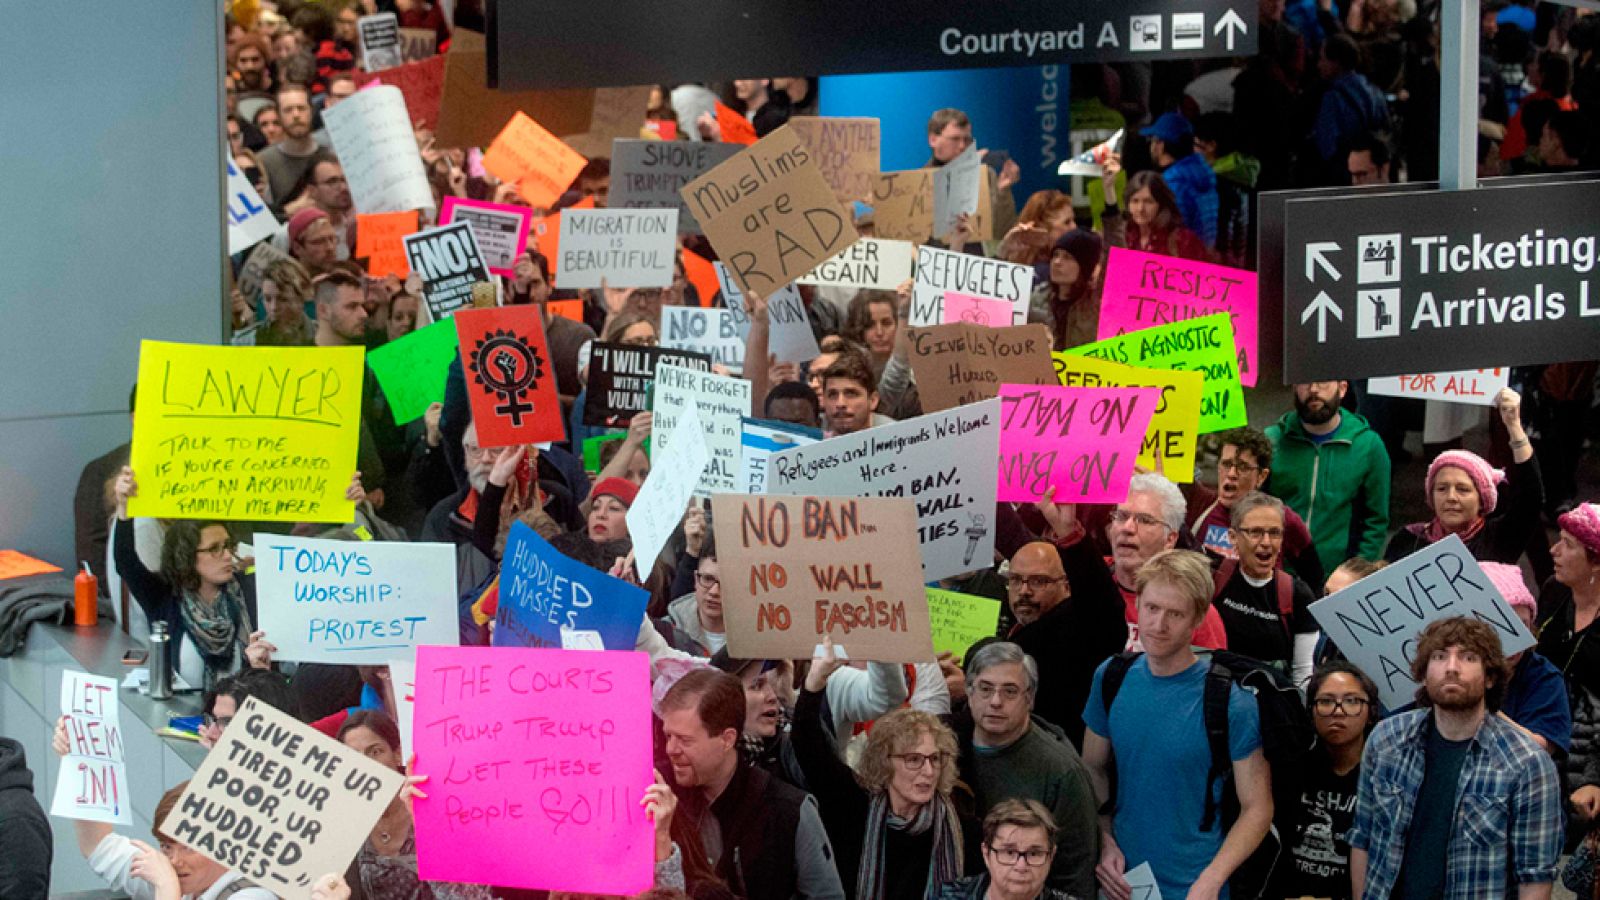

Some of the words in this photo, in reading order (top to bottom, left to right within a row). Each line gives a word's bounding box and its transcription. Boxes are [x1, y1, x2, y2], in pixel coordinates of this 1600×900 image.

[940, 22, 1084, 57] Courtyard
[1096, 21, 1120, 48] A
[641, 143, 707, 169] SHOVE
[693, 145, 809, 219] Muslims
[569, 215, 669, 236] MIGRATION
[743, 192, 793, 232] are
[564, 249, 667, 272] BEAUTIFUL
[730, 207, 843, 289] RAD
[915, 247, 1027, 302] REFUGEES
[1140, 260, 1244, 302] RESIST
[669, 309, 707, 341] NO
[1410, 283, 1566, 330] Arrivals
[1140, 324, 1221, 362] AGNOSTIC
[612, 349, 653, 376] WILL
[162, 361, 343, 419] LAWYER
[613, 375, 641, 390] WITH
[658, 366, 698, 392] NEVER
[702, 376, 748, 399] FORGET
[1443, 375, 1485, 396] ALL
[1002, 390, 1079, 438] WALL
[160, 432, 213, 456] TALK
[225, 436, 250, 451] TO
[256, 436, 287, 451] ME
[776, 452, 841, 486] Refugees
[842, 440, 867, 463] and
[871, 427, 931, 458] Immigrants
[934, 412, 991, 440] Welcome
[155, 461, 171, 477] IF
[242, 454, 330, 473] CONCERNED
[911, 467, 961, 496] BAN.
[1000, 450, 1059, 496] BAN
[160, 476, 214, 498] ABOUT
[218, 478, 239, 493] AN
[246, 475, 329, 497] ARRIVING
[176, 497, 235, 516] FAMILY
[741, 497, 790, 548] NO
[270, 545, 373, 577] TODAY'S
[512, 539, 593, 609] HUDDLED
[750, 561, 788, 596] NO
[809, 562, 883, 593] WALL
[294, 581, 401, 604] WORSHIP:
[510, 575, 578, 631] MASSES
[1335, 552, 1484, 647] NEVER
[309, 616, 427, 645] PROTEST
[756, 602, 792, 633] NO
[71, 677, 112, 716] LET
[433, 664, 493, 705] THE
[508, 664, 614, 695] COURTS
[76, 762, 120, 816] IN!
[228, 739, 294, 797] TIRED,
[294, 779, 331, 812] UR
[301, 745, 343, 779] ME
[343, 767, 383, 802] UR
[443, 756, 511, 785] LET
[524, 757, 603, 781] THESE
[206, 766, 280, 824] POOR,
[285, 811, 323, 845] UR
[181, 792, 303, 867] HUDDLED
